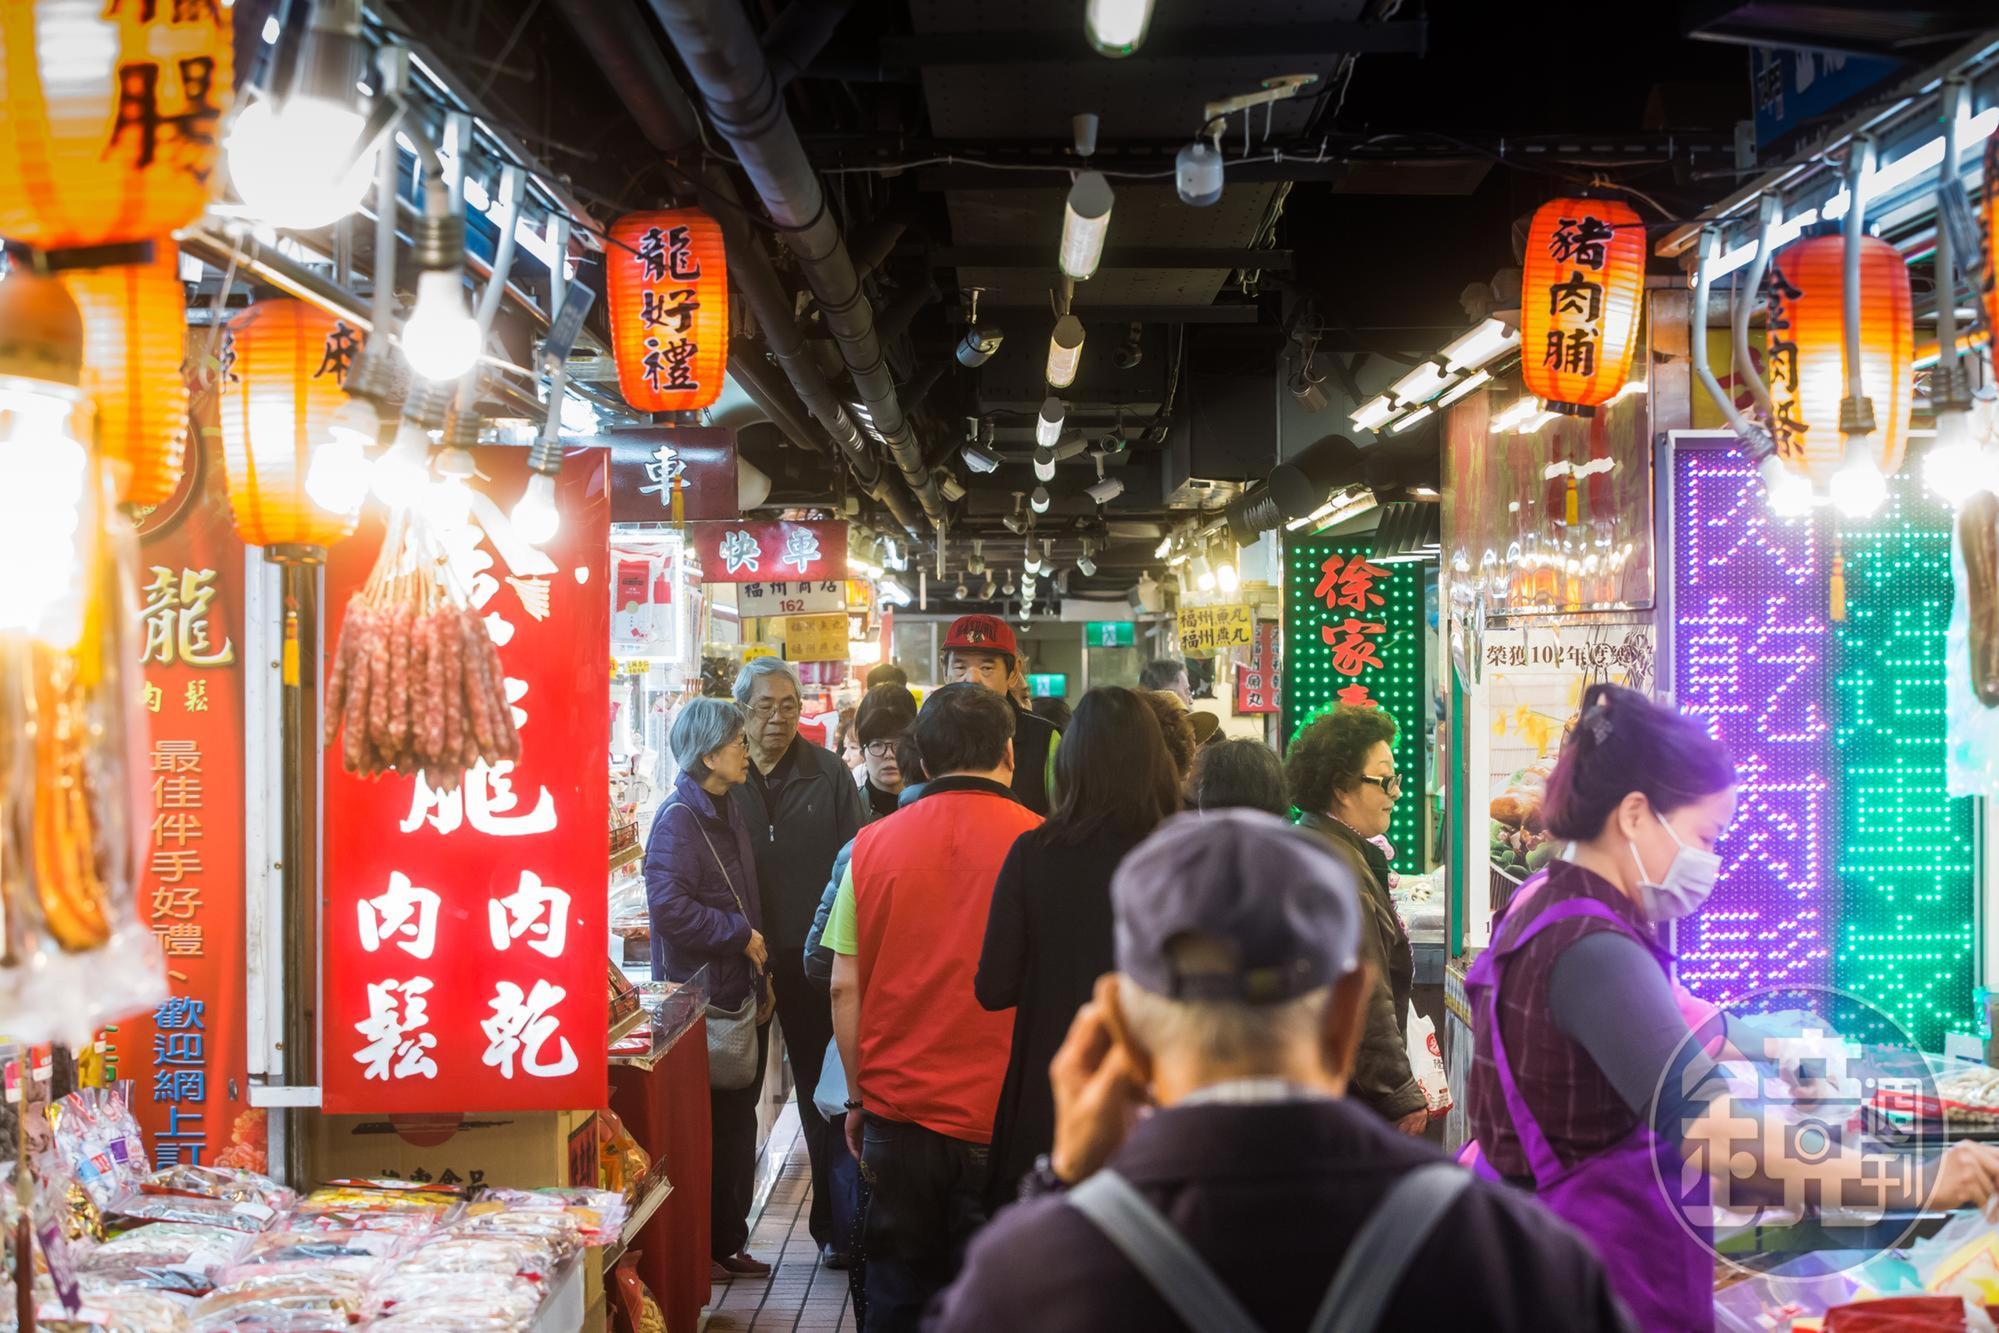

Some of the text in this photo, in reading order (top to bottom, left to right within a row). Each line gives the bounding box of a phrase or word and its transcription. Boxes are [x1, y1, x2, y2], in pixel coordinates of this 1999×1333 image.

[636, 226, 701, 391] 龍好禮
[1544, 215, 1613, 377] 豬肉脯
[639, 446, 691, 506] 車
[719, 530, 822, 574] 快車
[779, 600, 805, 612] 162
[353, 869, 442, 1080] 肉鬆
[480, 869, 579, 1079] 肉乾
